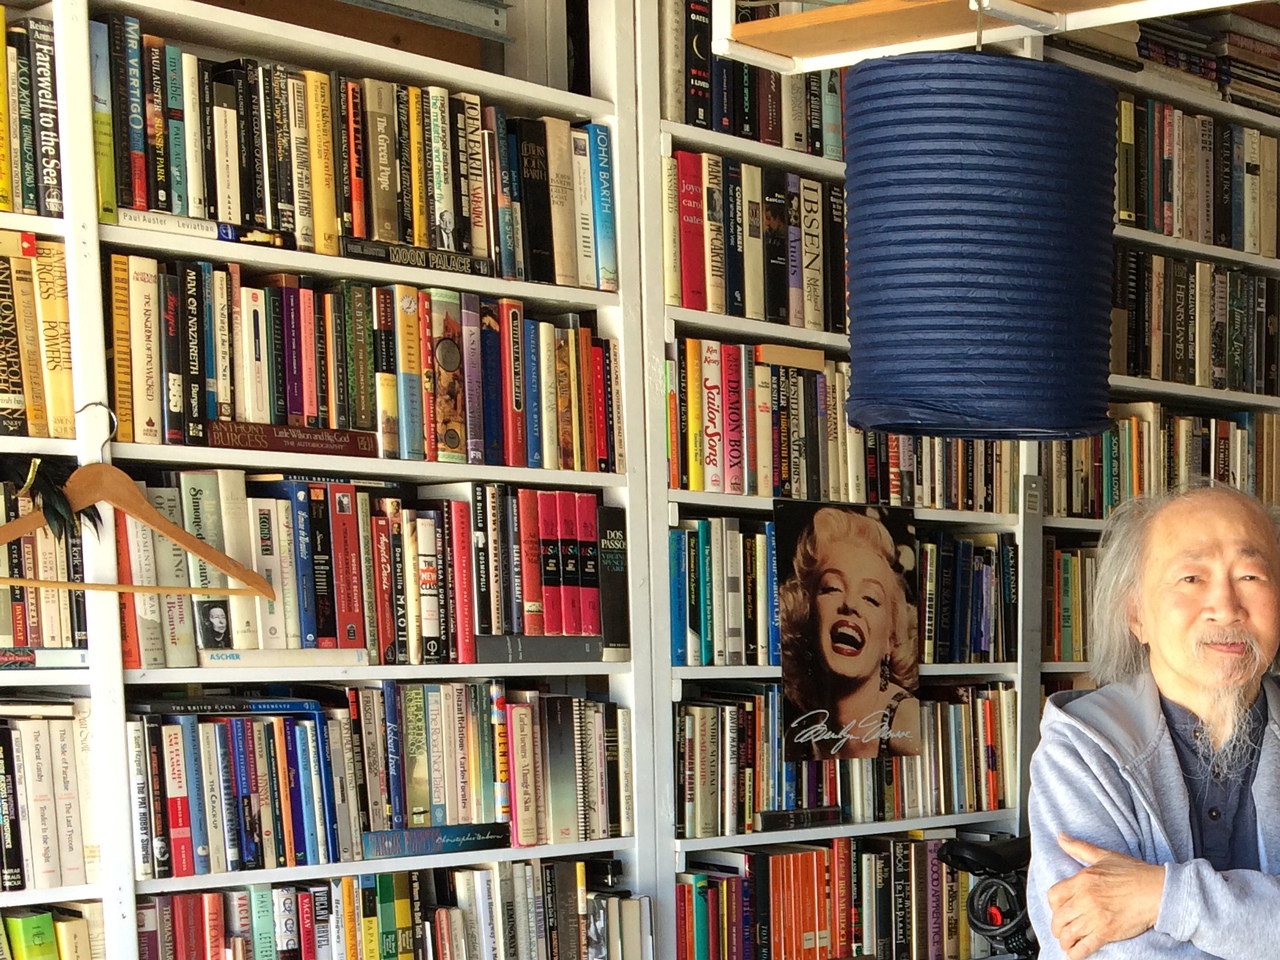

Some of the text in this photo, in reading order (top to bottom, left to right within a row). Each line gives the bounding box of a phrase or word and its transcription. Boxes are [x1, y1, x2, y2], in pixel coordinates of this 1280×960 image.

[690, 13, 709, 24] OATES
[128, 58, 144, 130] VERTIGO
[151, 48, 164, 113] PAUL AUSTER
[169, 57, 181, 102] invisible
[695, 79, 710, 89] LIVED
[36, 43, 62, 187] Farewell to the Sea
[154, 117, 166, 182] SUNSET PARK
[376, 117, 392, 191] The Green Pope
[464, 100, 483, 185] JOHN BARTH
[596, 129, 612, 214] JOHN BARTH
[708, 157, 722, 190] MARY
[123, 212, 215, 234] Paul Auster Leviathan
[803, 186, 821, 276] IBSEN
[37, 247, 56, 300] BURGESS
[389, 247, 471, 274] MOON PALACE
[187, 270, 200, 375] MAN OF NAZARETH
[1176, 284, 1186, 319] HENRY
[42, 321, 63, 371] POWERS
[212, 421, 264, 434] ANTHONY
[213, 432, 269, 449] BURGESS
[703, 377, 722, 468] Sailor Song
[728, 378, 743, 469] DEMON BOX
[1111, 435, 1120, 457] SONS
[188, 486, 204, 529] Simone
[606, 530, 623, 540] DOS
[378, 532, 392, 591] Angela Davis
[421, 571, 437, 581] NEW
[423, 560, 434, 570] THE
[479, 551, 487, 594] COSMOPOLIS
[420, 582, 437, 592] CLASS
[15, 605, 24, 641] DANTICAT
[167, 600, 178, 646] Beauvoir
[397, 595, 407, 628] MAO
[209, 653, 241, 662] ASCHER
[362, 695, 372, 725] FRISCH
[455, 688, 466, 752] Distant Relations
[857, 709, 915, 743] Monroe
[34, 743, 42, 761] Great
[386, 722, 400, 777] Robert Frost
[430, 709, 442, 804] The Road Not Taken
[497, 723, 509, 784] FUENTES
[520, 735, 529, 760] Fuentes
[729, 710, 737, 766] DAVID MAMET
[458, 757, 468, 809] Carlos Fuentes
[138, 815, 149, 838] HOBBY
[210, 794, 219, 830] CRACK-UP
[163, 904, 172, 937] THOMAS
[256, 893, 269, 920] HAVEL
[314, 886, 330, 950] VACLAV HAVEL
[334, 898, 342, 946] Hemingway
[930, 857, 942, 948] GOOD APPRENTICE
[505, 901, 517, 958] HEMINGWAY'S
